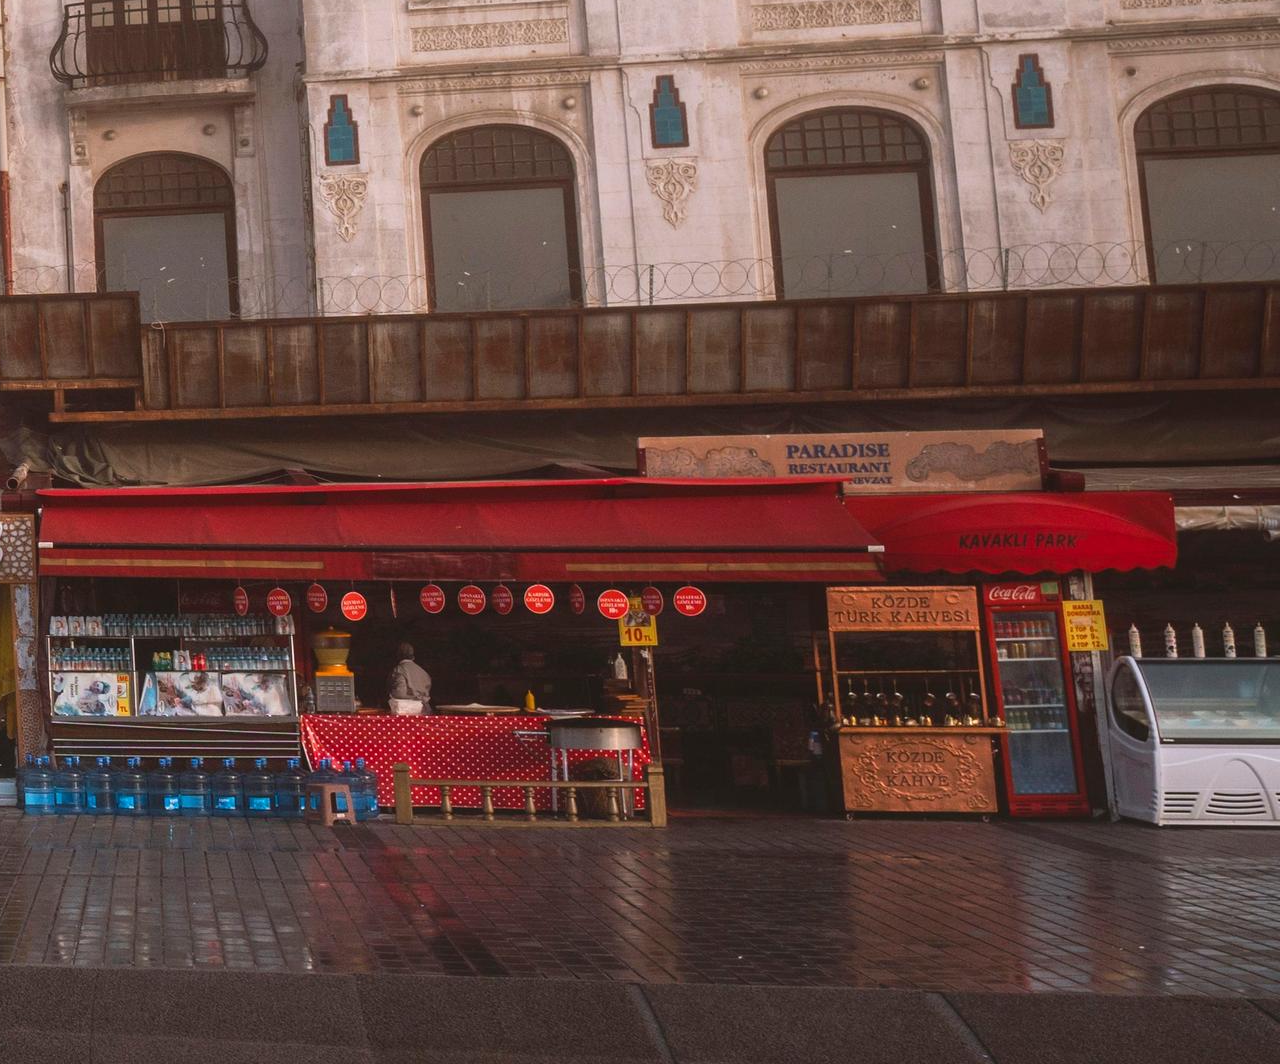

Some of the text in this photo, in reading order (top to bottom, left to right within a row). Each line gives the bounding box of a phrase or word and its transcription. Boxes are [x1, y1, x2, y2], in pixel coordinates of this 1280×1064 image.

[786, 443, 890, 459] PARADISE
[788, 462, 891, 474] RESTAURANT
[1035, 533, 1079, 548] PARK
[871, 594, 930, 609] KÖZDE
[834, 609, 972, 623] TÜRK KAHVESİ
[624, 628, 643, 642] 10
[886, 749, 945, 764] KÖZDE
[886, 776, 950, 787] KAHVE
